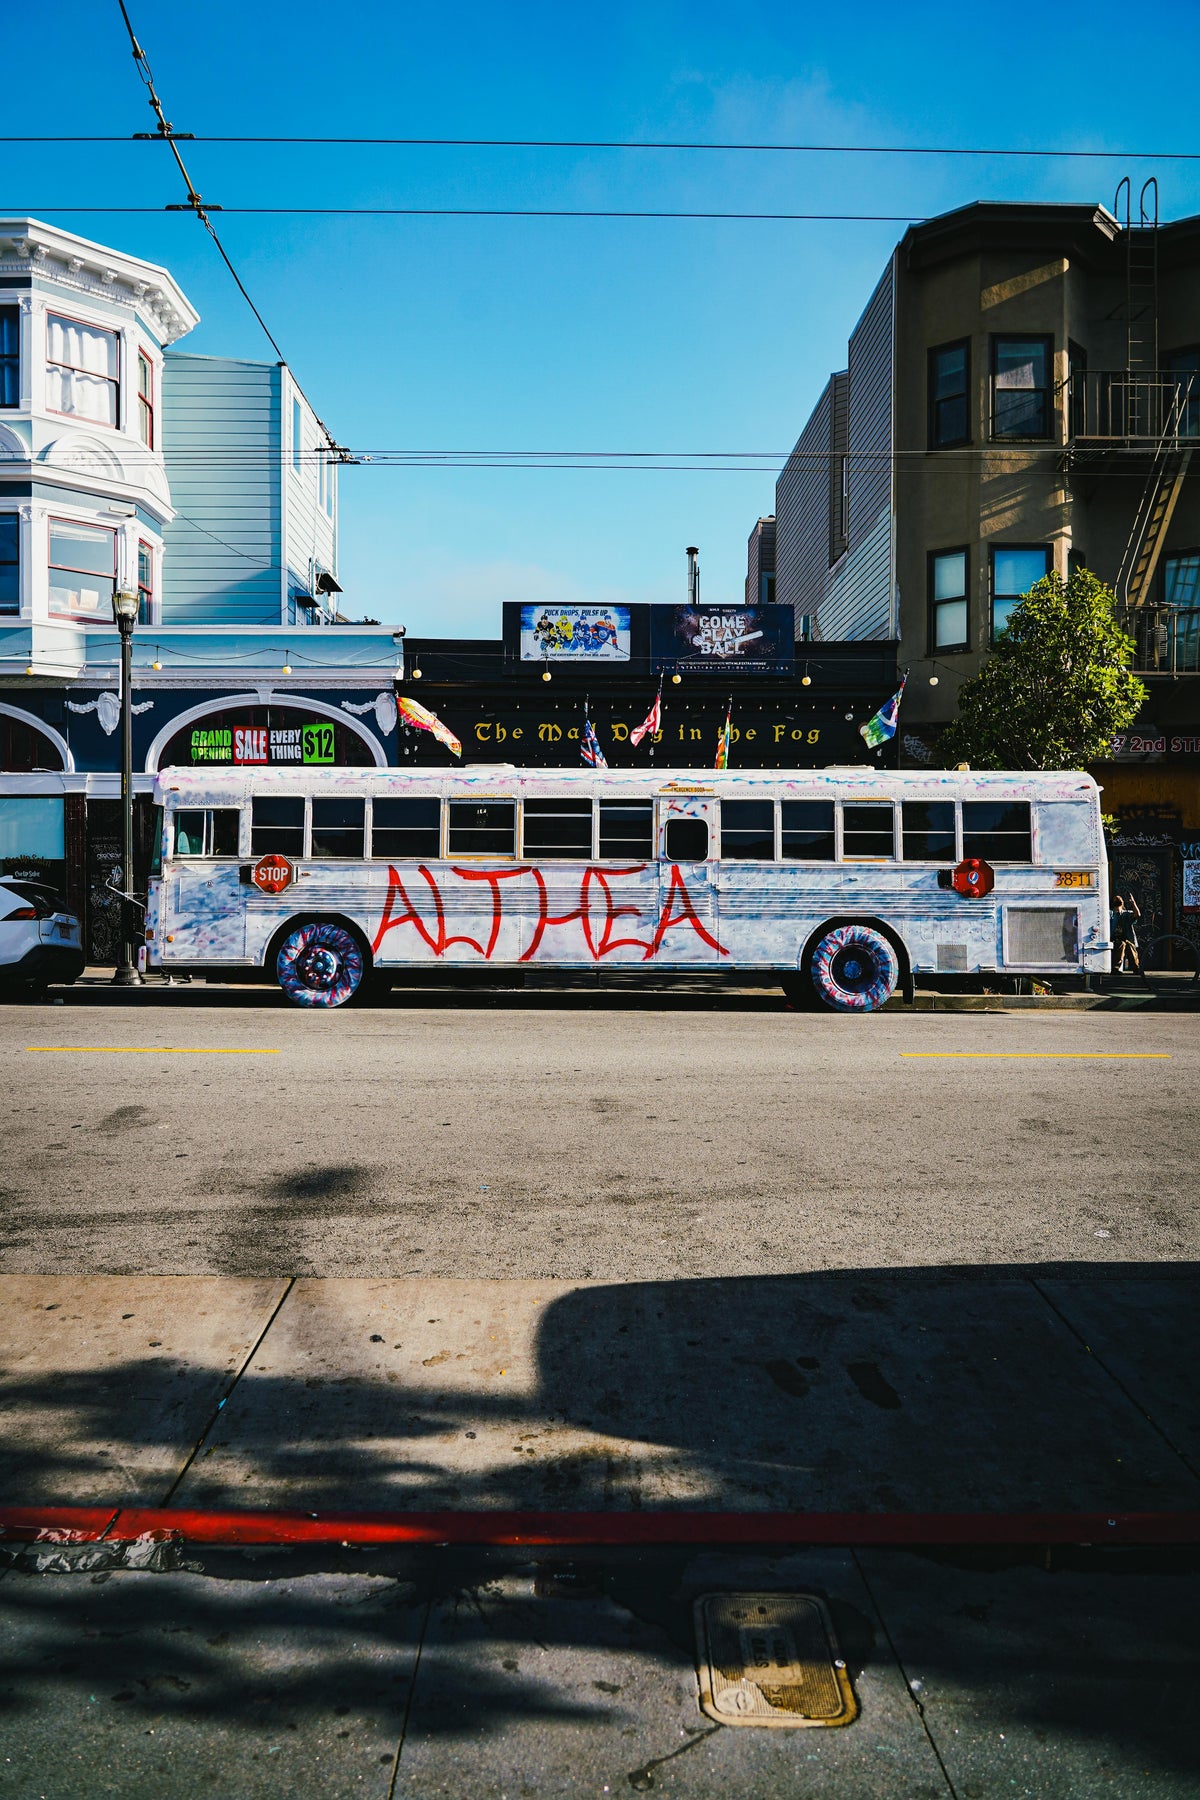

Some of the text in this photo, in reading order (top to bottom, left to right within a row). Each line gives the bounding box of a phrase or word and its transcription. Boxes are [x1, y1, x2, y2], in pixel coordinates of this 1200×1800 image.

[560, 609, 580, 617] DROPS,
[699, 616, 746, 629] COME
[701, 628, 746, 641] PLAY
[700, 641, 745, 654] BALL
[191, 729, 232, 747] GRAND
[270, 729, 301, 744] EVERY
[474, 722, 821, 744] The Ma Dg in the Fog
[235, 729, 267, 760] SALE
[304, 728, 334, 759] $12
[1130, 736, 1166, 753] 2nd
[191, 747, 232, 760] OPENING
[270, 745, 302, 760] THING
[258, 866, 289, 882] STOP
[372, 864, 730, 962] ALTHEA
